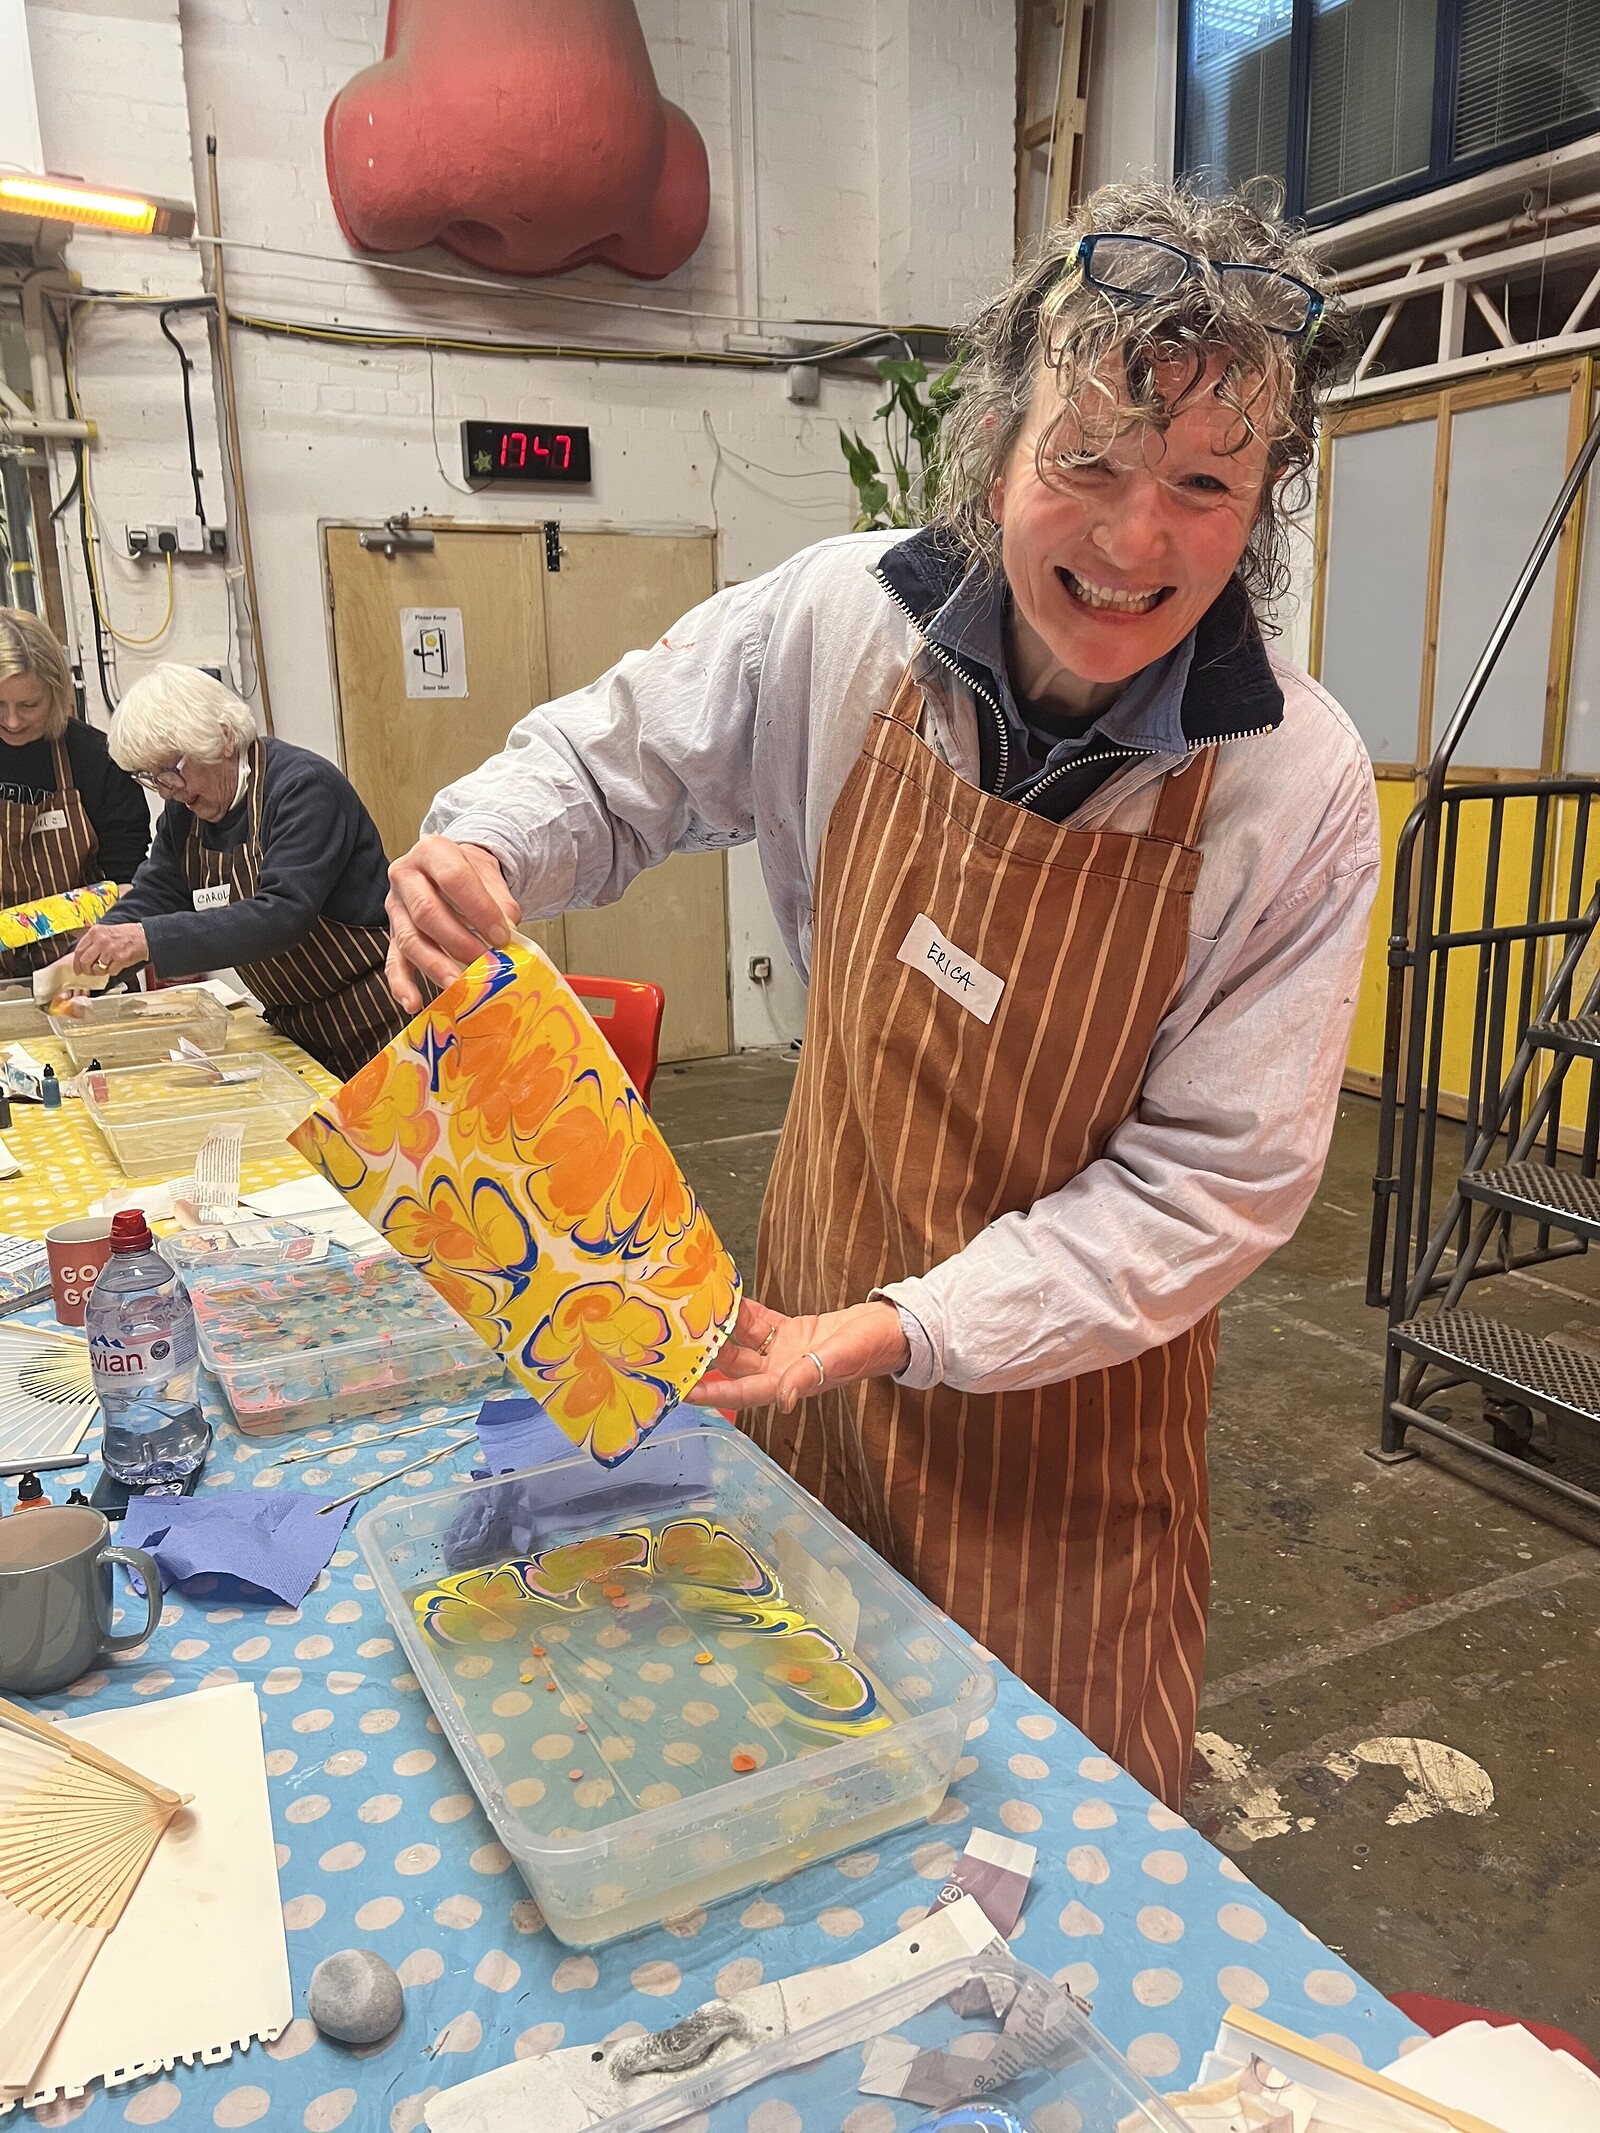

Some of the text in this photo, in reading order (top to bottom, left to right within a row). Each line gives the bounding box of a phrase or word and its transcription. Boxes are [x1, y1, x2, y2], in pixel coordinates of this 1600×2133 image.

[197, 890, 230, 904] CAROL
[926, 940, 976, 992] ERICA
[60, 1263, 106, 1284] GO
